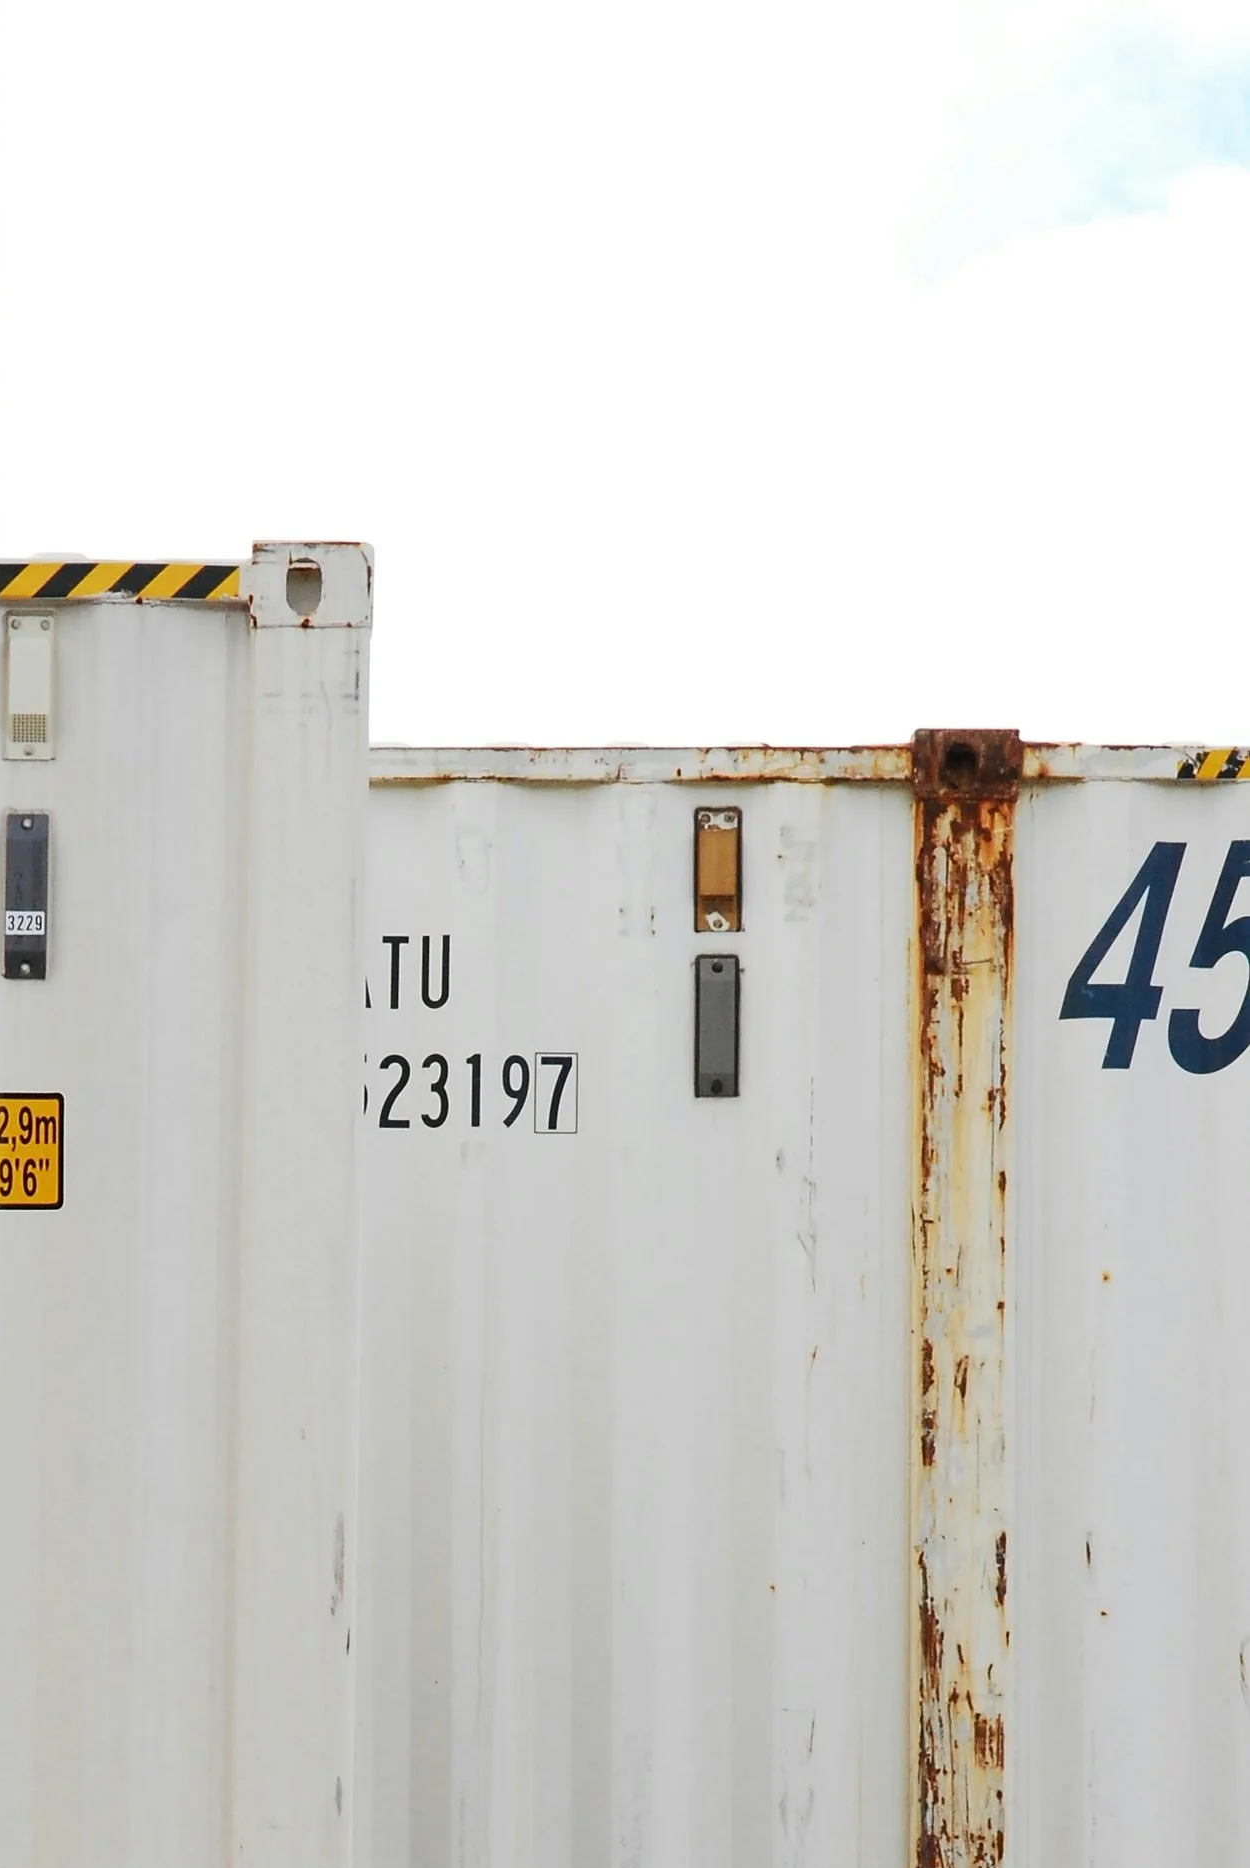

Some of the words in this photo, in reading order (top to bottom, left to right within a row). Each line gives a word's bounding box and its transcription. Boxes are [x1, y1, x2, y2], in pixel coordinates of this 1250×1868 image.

[7, 914, 44, 932] 3229
[1059, 840, 1250, 1075] 45
[365, 934, 451, 1010] TU
[364, 1053, 574, 1130] 23197
